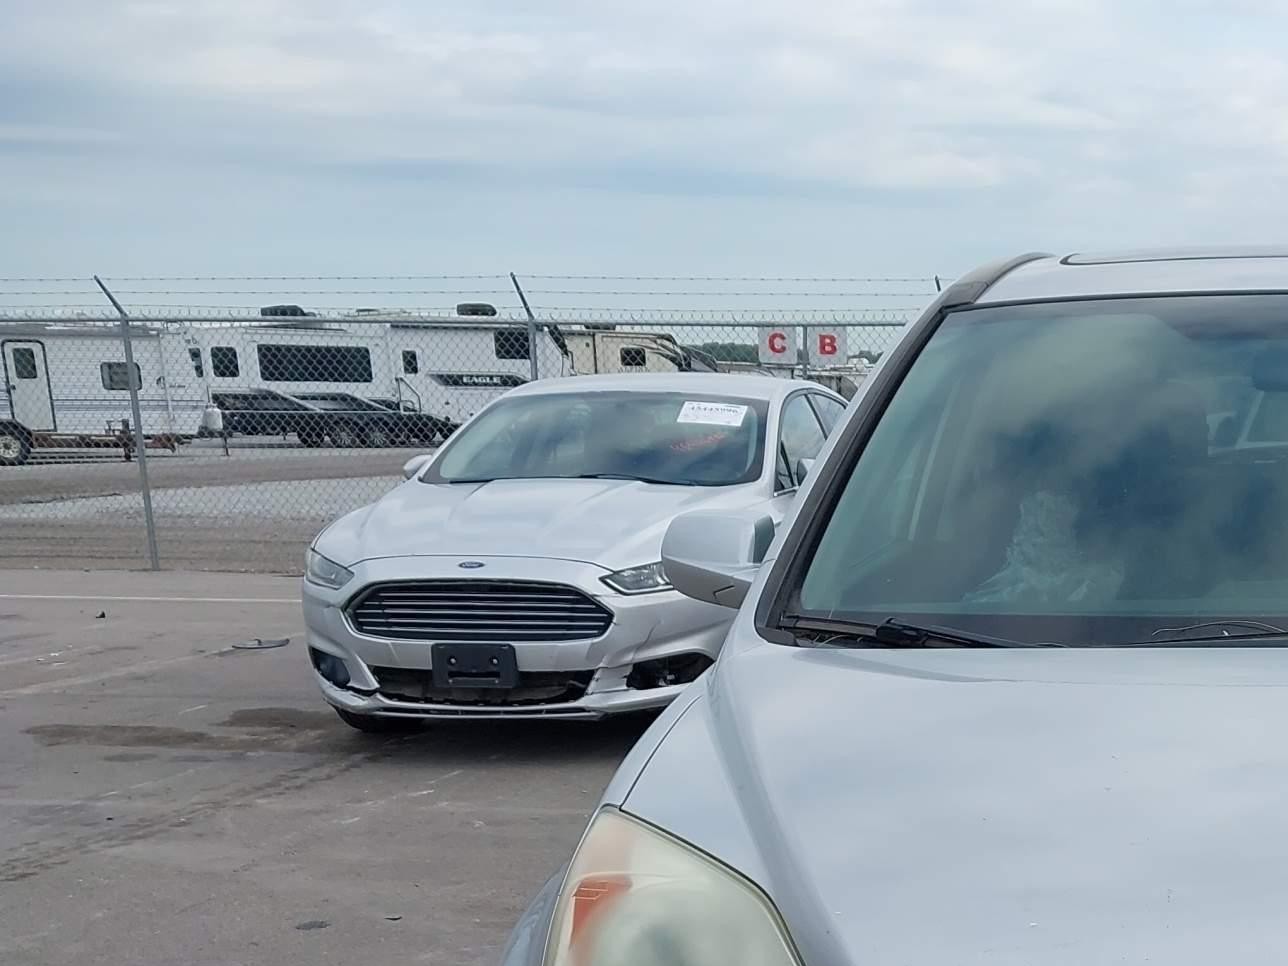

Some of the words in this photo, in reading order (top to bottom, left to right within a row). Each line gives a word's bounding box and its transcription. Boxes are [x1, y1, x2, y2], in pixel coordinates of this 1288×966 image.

[767, 332, 787, 354] C
[818, 334, 838, 355] B
[462, 375, 501, 384] EAGLE
